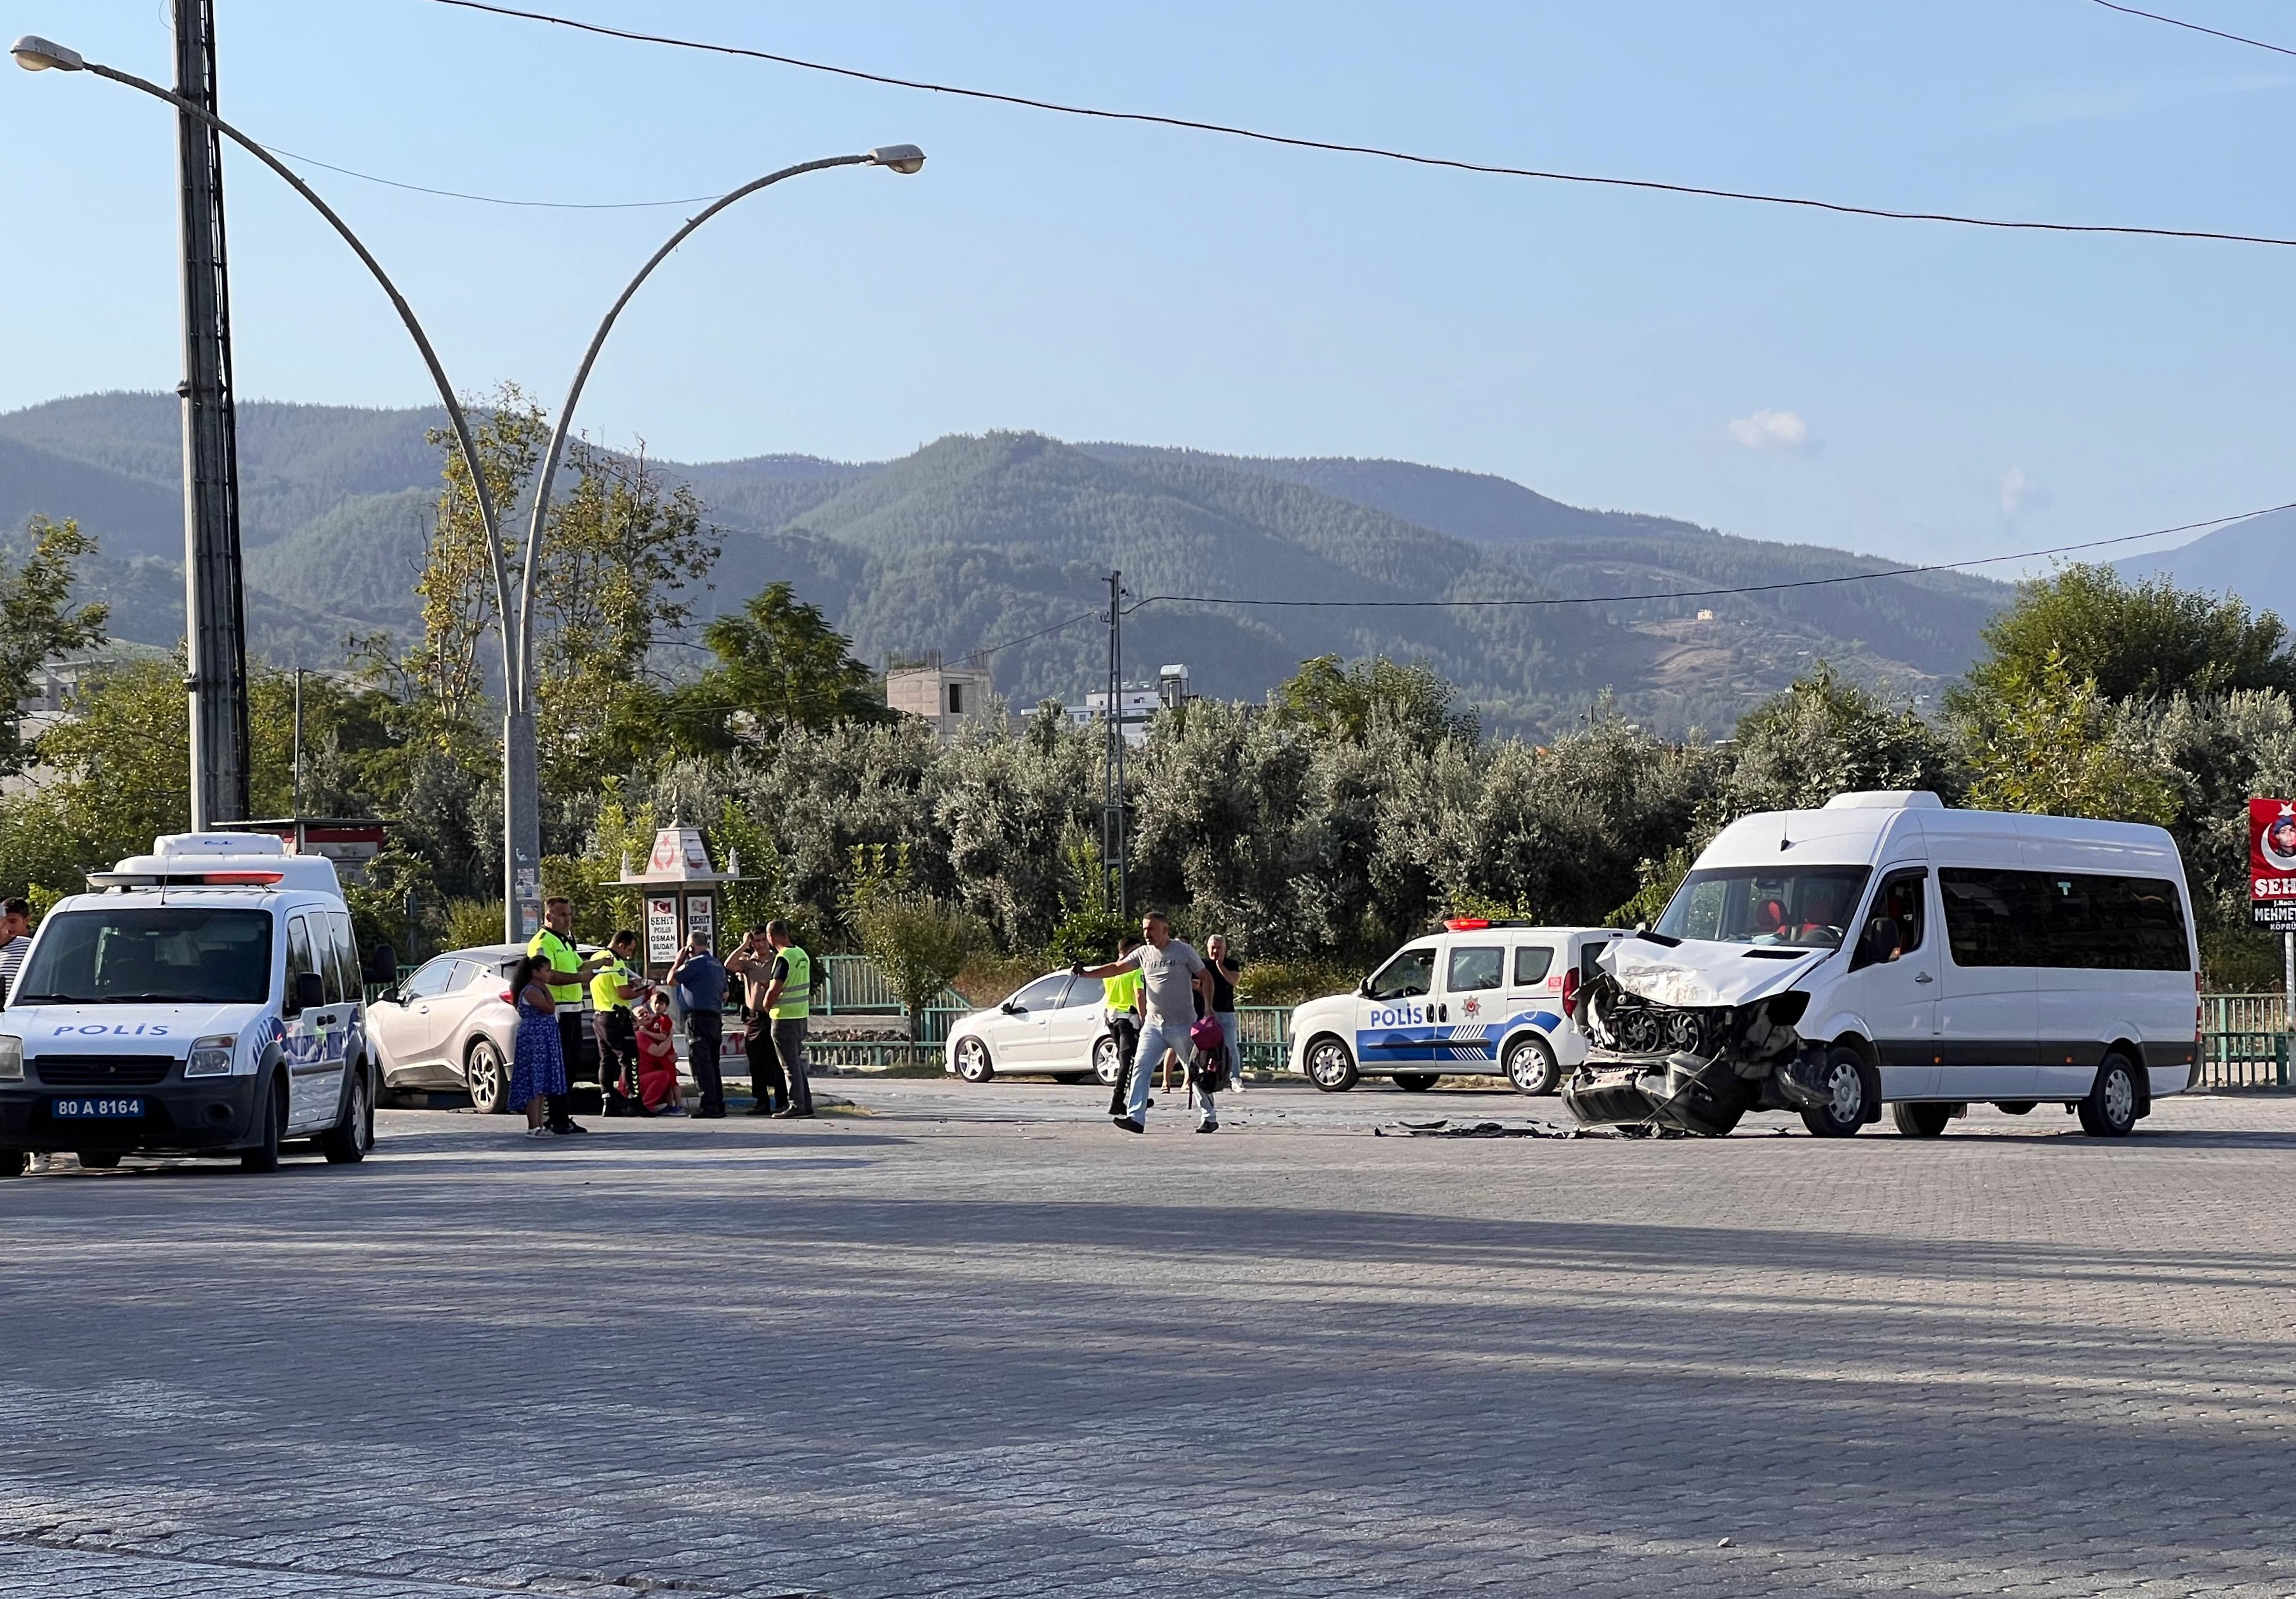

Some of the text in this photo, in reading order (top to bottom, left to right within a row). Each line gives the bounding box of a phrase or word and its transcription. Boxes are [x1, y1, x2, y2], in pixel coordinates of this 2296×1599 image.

[1550, 978, 1560, 986] 112
[1371, 1003, 1423, 1027] POLİS
[53, 1023, 169, 1036] POLİS
[58, 1100, 139, 1115] 80 A 8164
